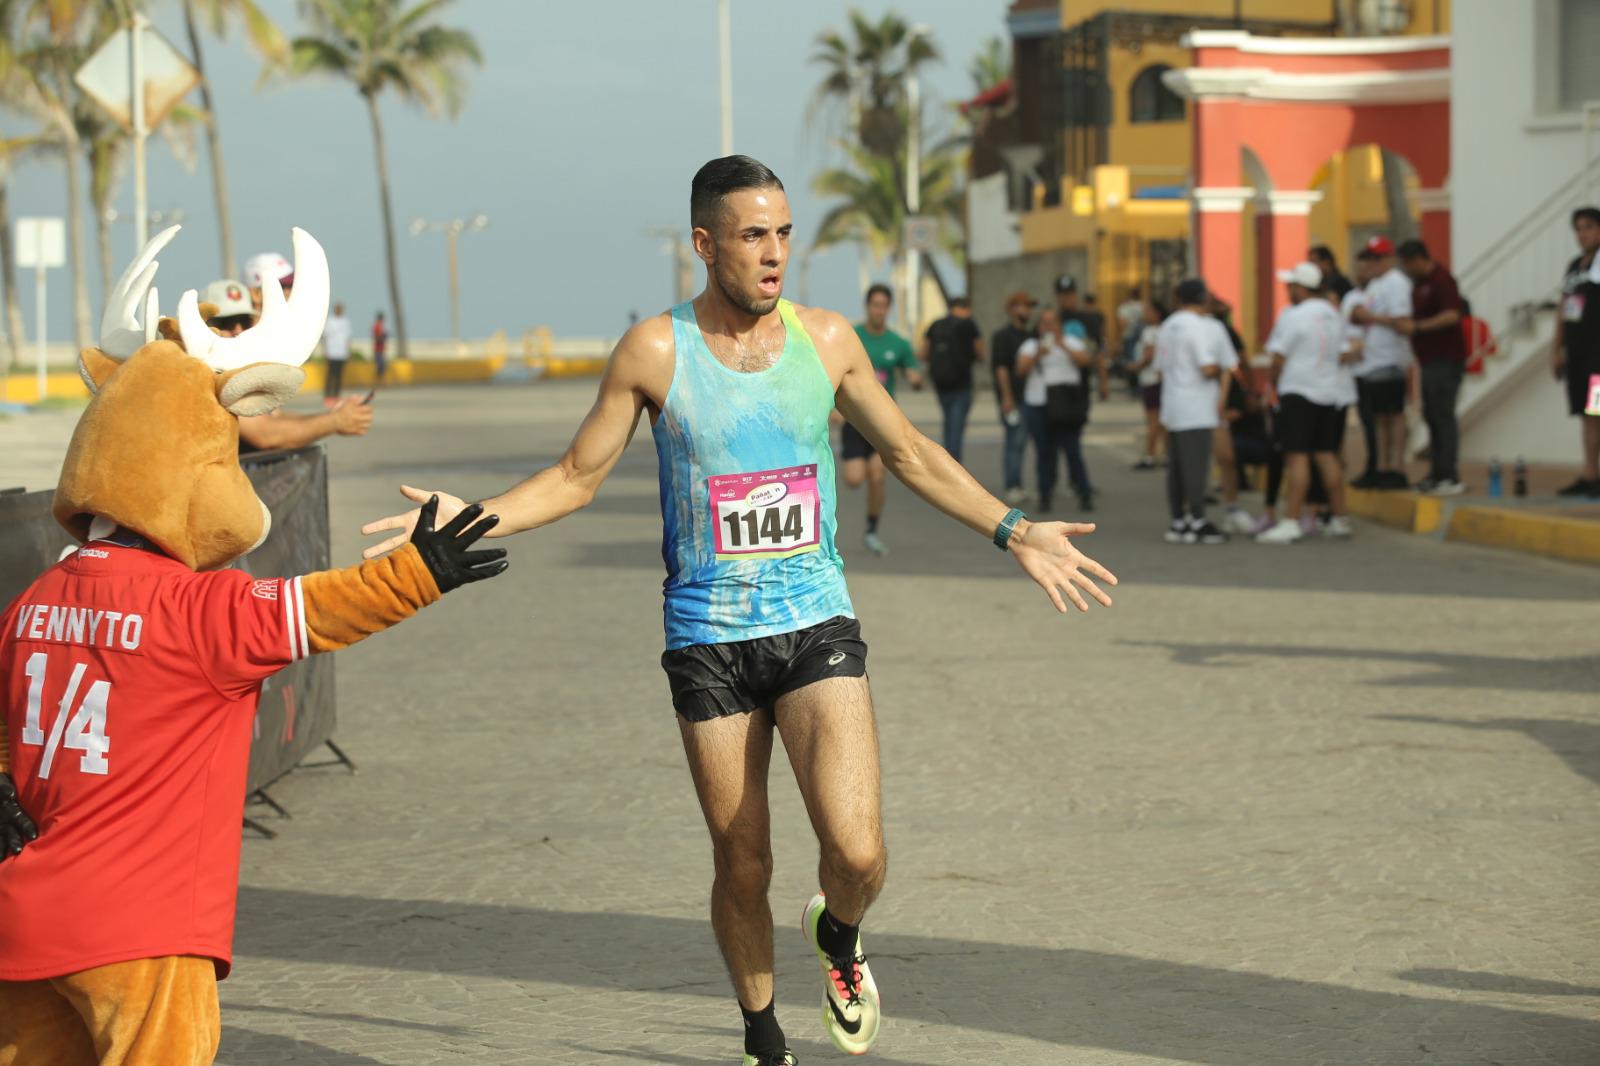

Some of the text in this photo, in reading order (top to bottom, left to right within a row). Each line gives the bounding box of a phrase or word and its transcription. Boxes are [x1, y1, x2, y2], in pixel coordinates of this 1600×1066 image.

[723, 504, 803, 546] 1144
[16, 605, 143, 650] VENNYTO
[22, 652, 112, 779] 1/4
